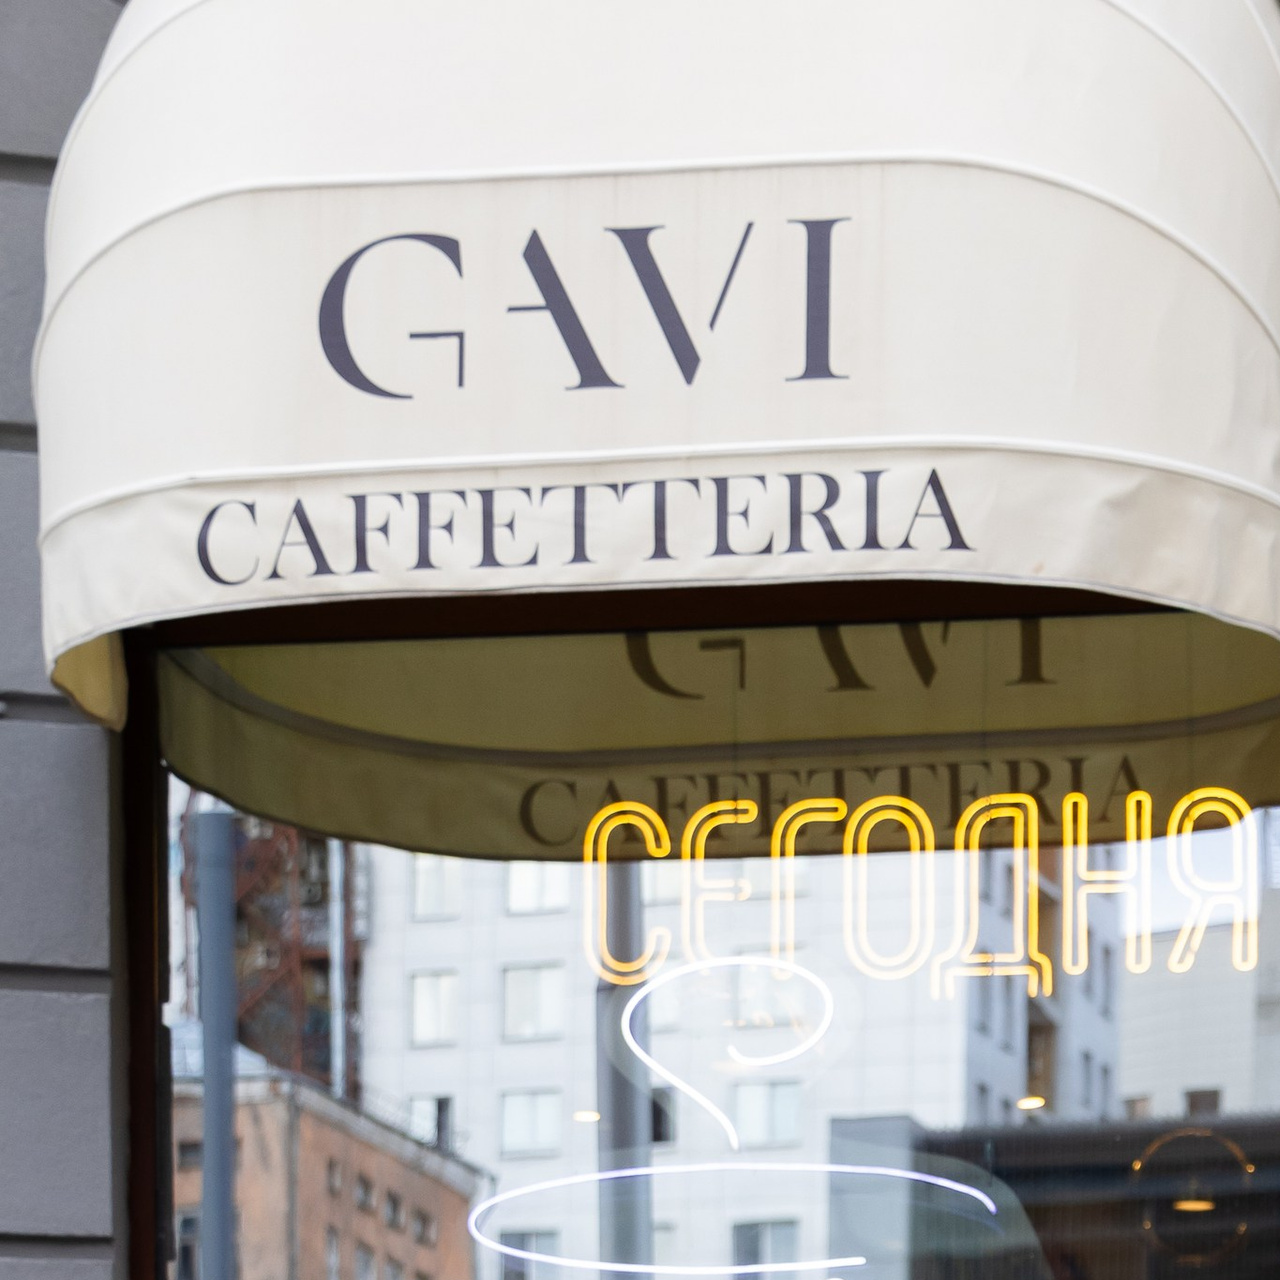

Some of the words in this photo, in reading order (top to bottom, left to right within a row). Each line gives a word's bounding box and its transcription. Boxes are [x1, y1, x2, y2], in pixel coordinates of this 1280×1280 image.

[318, 216, 852, 400] GAVI
[197, 468, 973, 586] CAFFETTERIA
[583, 787, 1259, 999] СЕГОДНЯ
